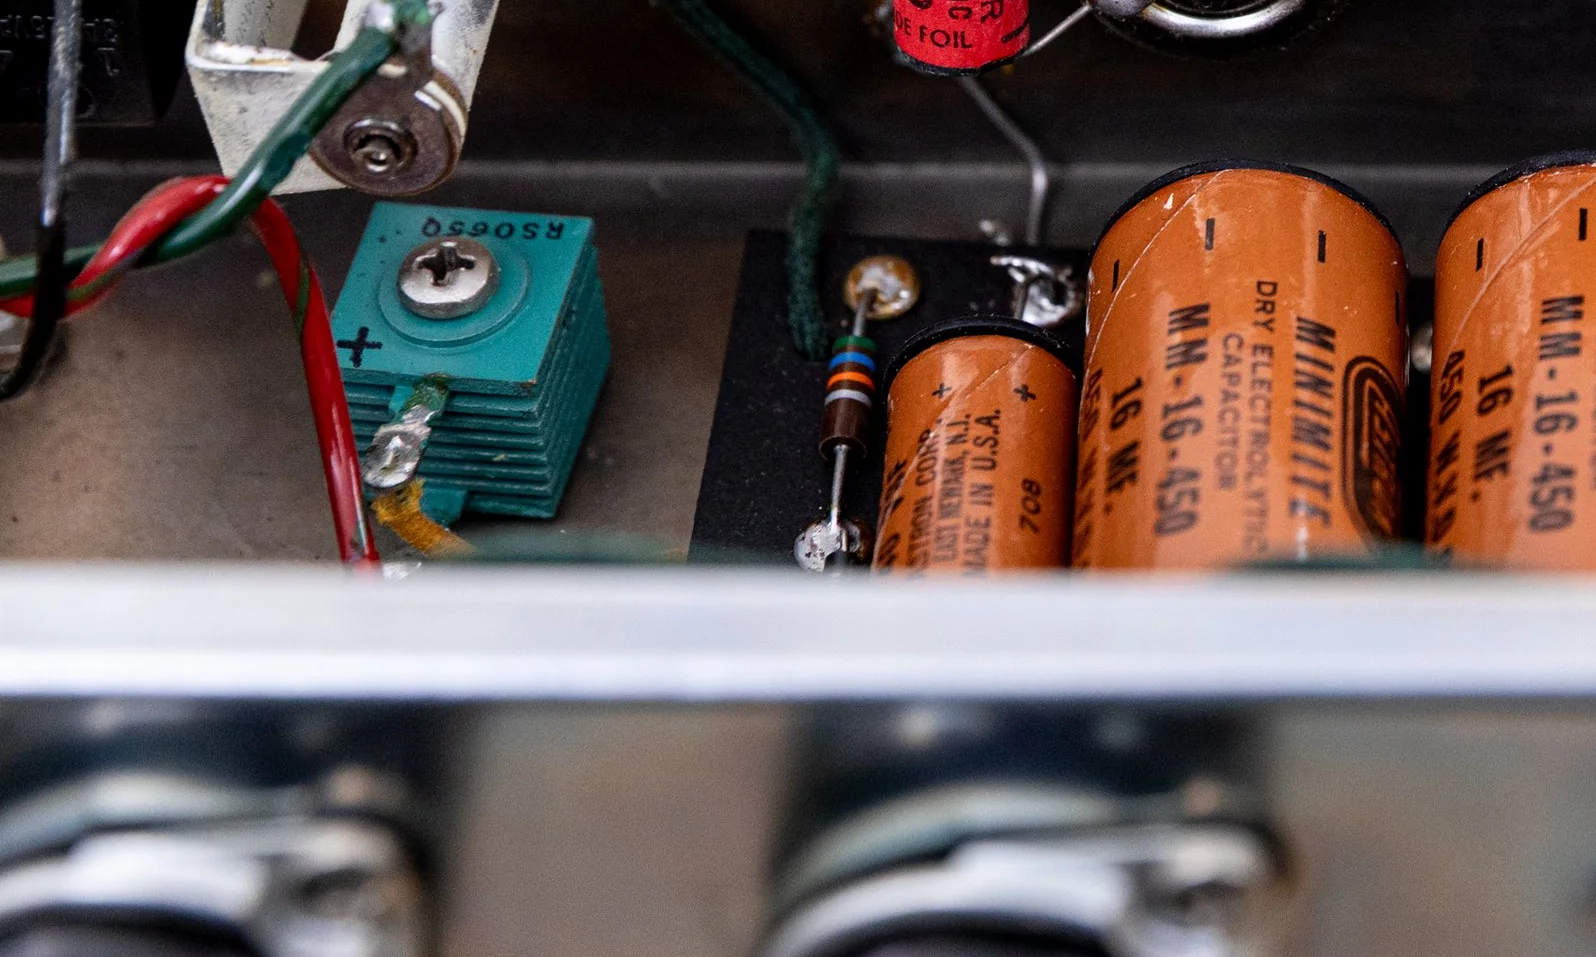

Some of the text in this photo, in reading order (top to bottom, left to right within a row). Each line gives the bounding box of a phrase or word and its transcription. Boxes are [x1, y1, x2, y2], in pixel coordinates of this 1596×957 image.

[919, 25, 973, 49] FOIL
[1252, 279, 1278, 334] DRY
[1110, 376, 1144, 431] 16
[1213, 331, 1244, 491] CAPACITOR
[1476, 363, 1514, 417] 16
[972, 408, 1003, 472] U.S.A.
[1288, 316, 1337, 528] MINIMITE
[969, 482, 994, 507] IN
